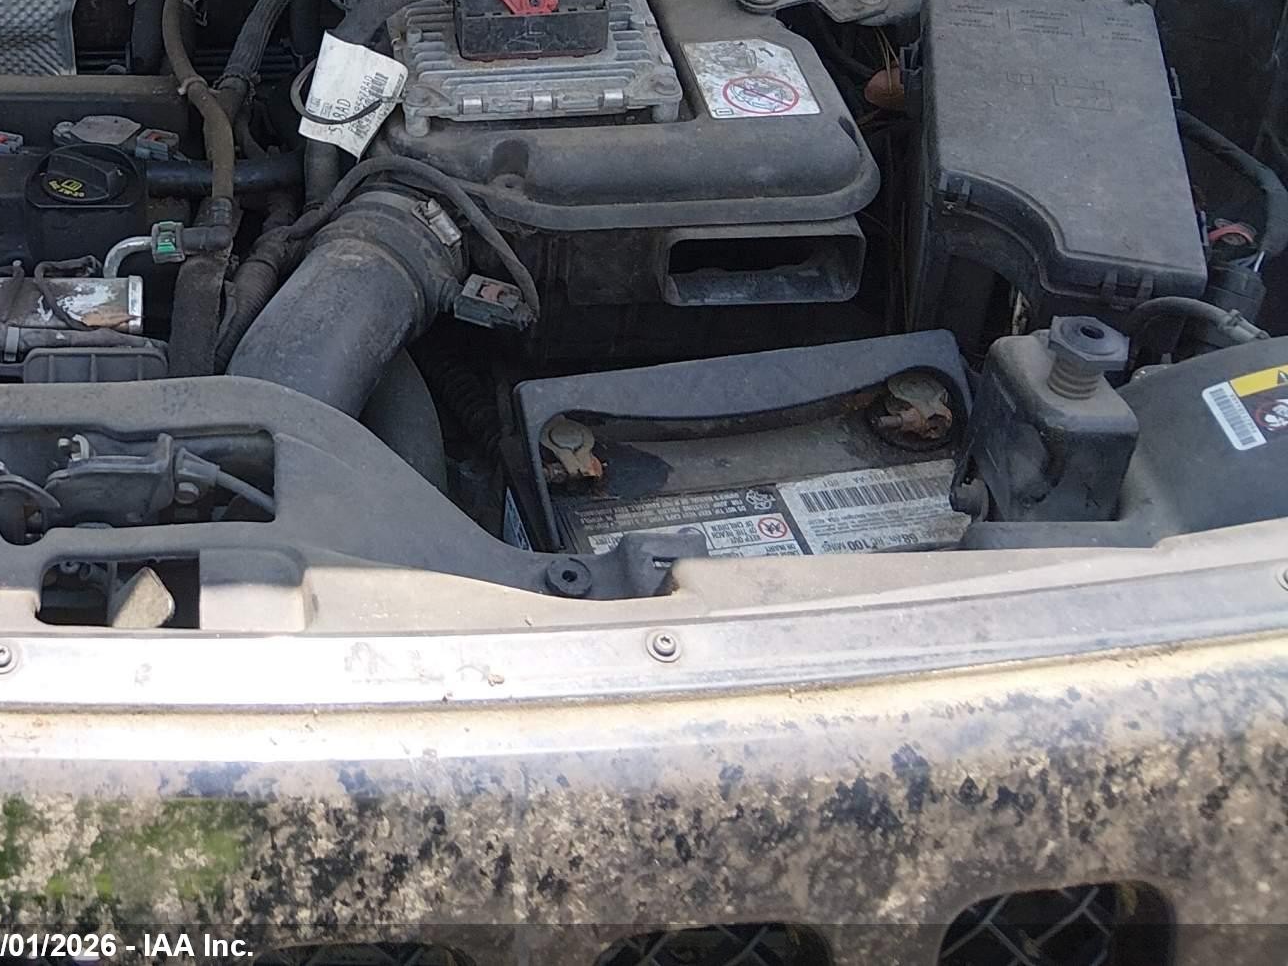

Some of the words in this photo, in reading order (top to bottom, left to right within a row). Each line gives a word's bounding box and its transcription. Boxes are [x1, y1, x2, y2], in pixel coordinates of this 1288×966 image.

[328, 98, 350, 133] 58AD
[711, 522, 743, 531] CHILDREN
[711, 530, 733, 538] REACH
[847, 539, 870, 550] 100
